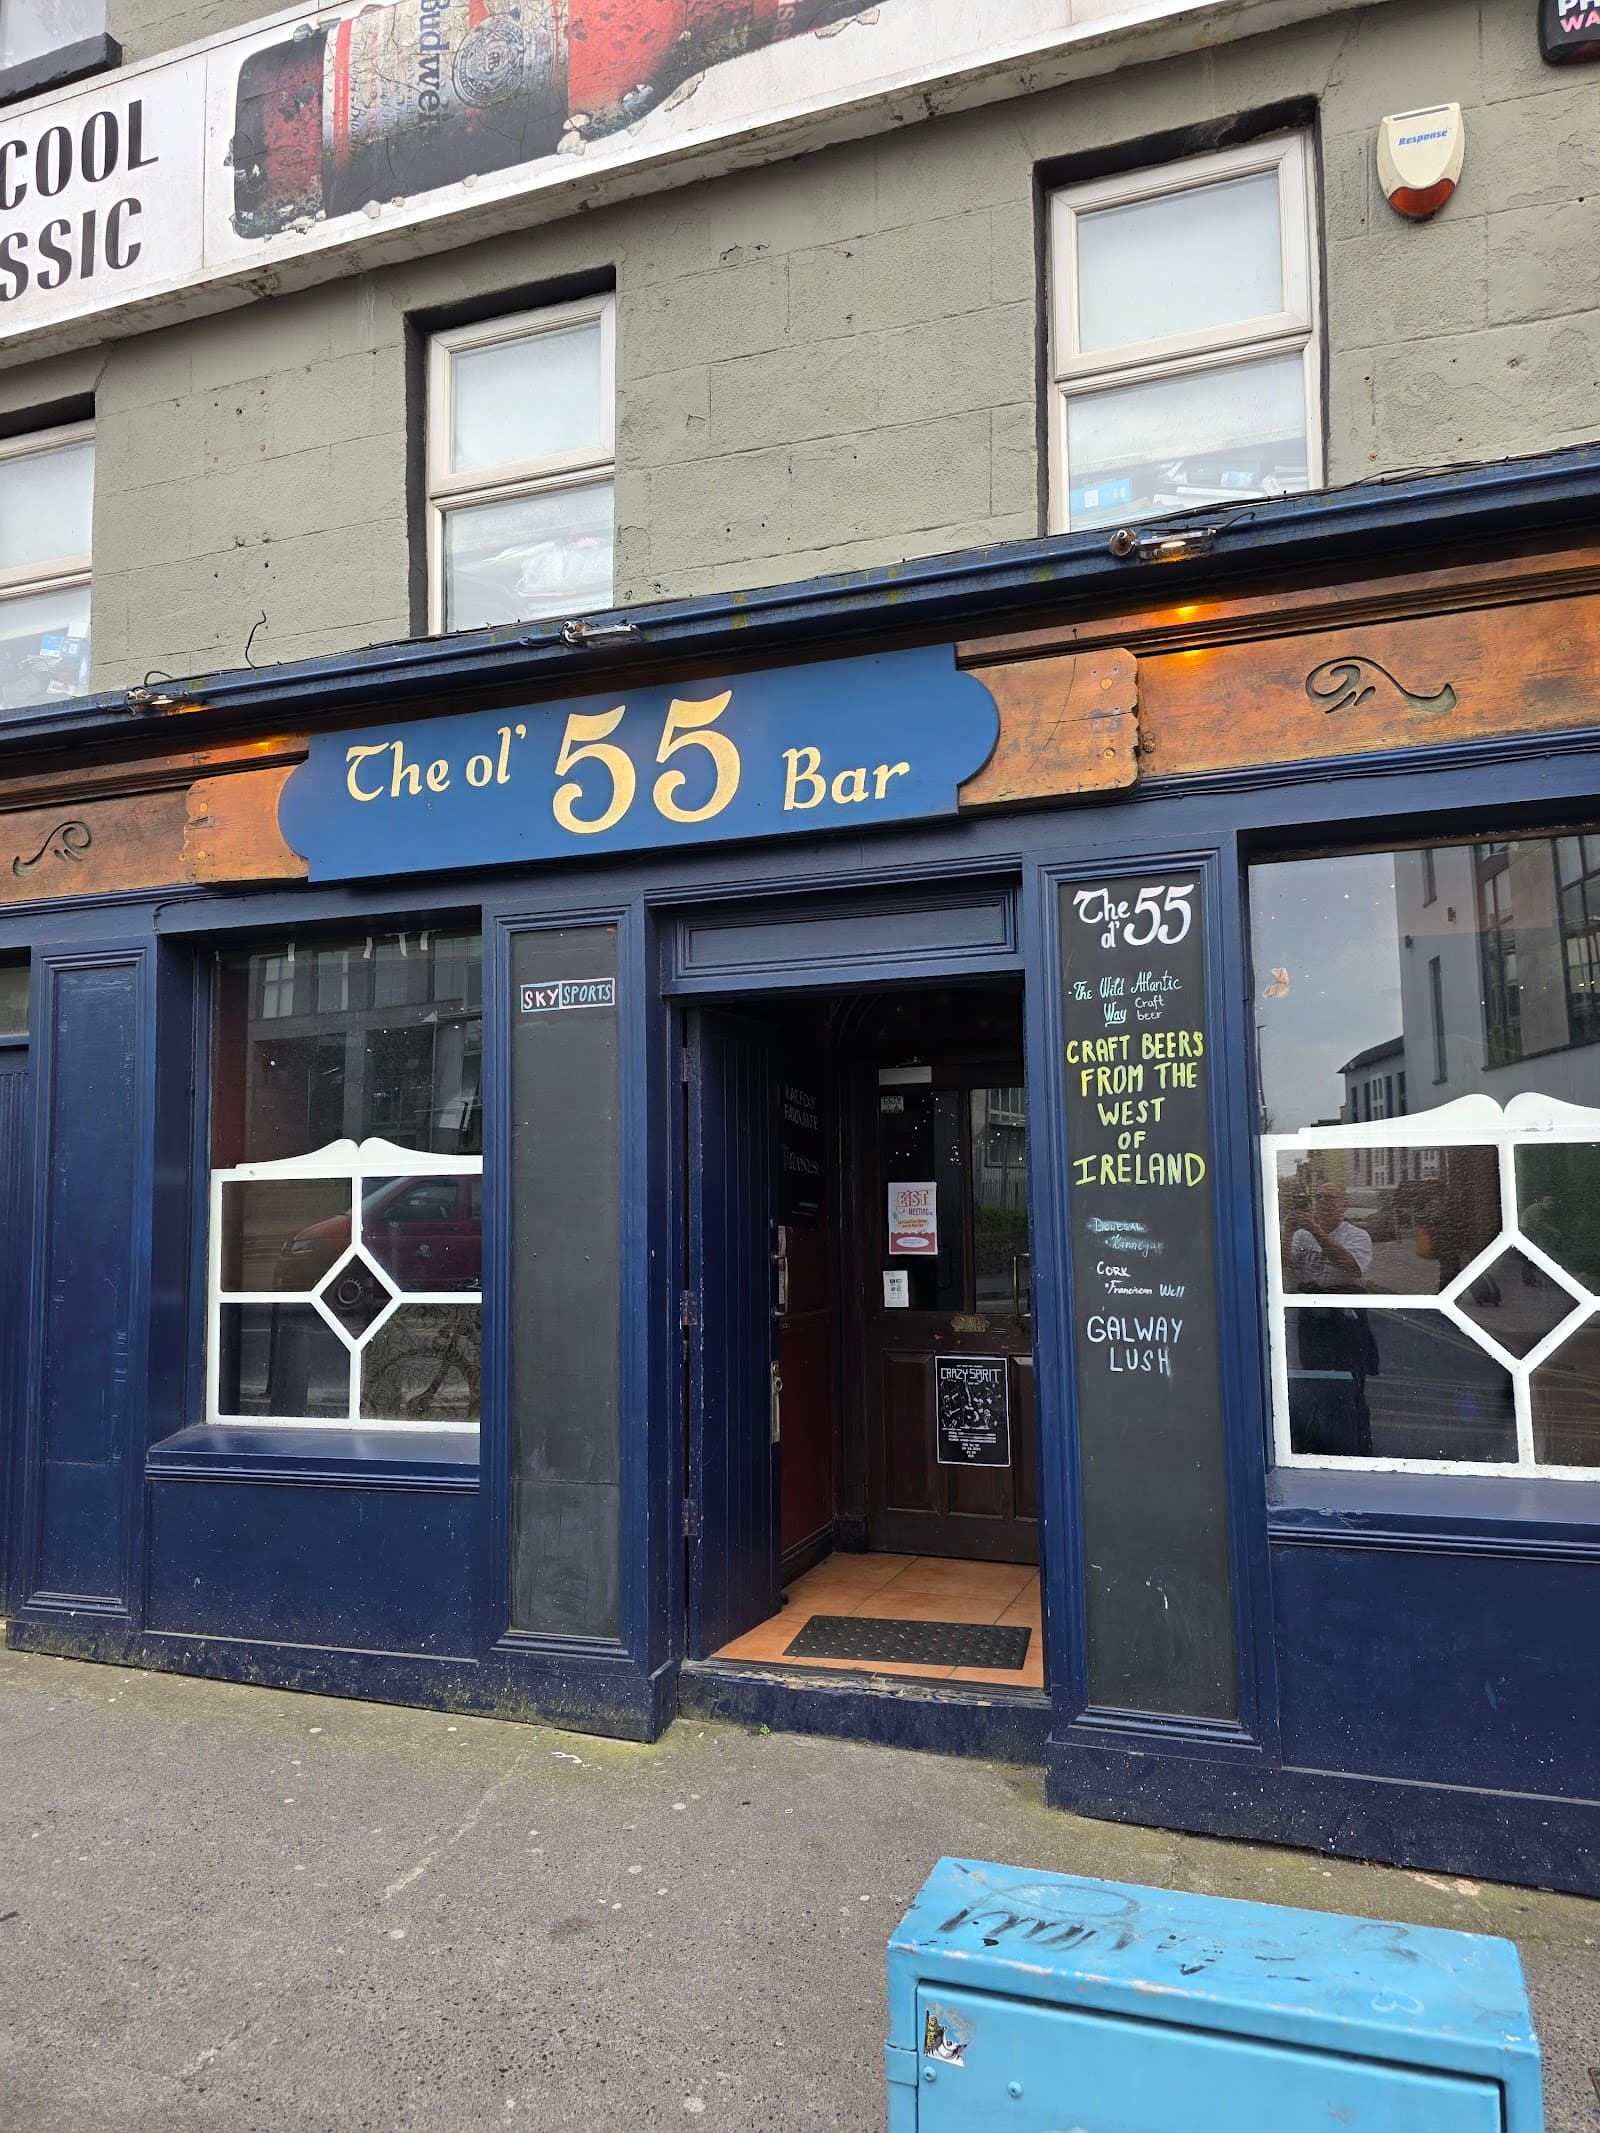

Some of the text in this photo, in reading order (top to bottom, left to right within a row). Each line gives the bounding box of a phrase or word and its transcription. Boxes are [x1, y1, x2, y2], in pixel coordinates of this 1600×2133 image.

[1398, 128, 1448, 146] Response
[0, 99, 159, 211] COOL
[0, 197, 142, 302] SSIC
[346, 690, 910, 834] The ol' 55 Bar
[1073, 884, 1194, 946] The 55
[524, 984, 612, 1010] SKY SPORTS
[1073, 980, 1093, 1001] The
[1100, 976, 1124, 998] Wild
[1135, 995, 1165, 1009] Craft
[1104, 1002, 1127, 1027] Way
[1137, 1010, 1163, 1021] beer
[1066, 1030, 1204, 1064] CRAFT BEERS
[1081, 1062, 1198, 1097] FROM THE
[1097, 1097, 1165, 1126] WEST
[1118, 1130, 1146, 1150] OF
[1073, 1153, 1206, 1187] IRELAND
[1087, 1316, 1183, 1344] GALWAY
[940, 1367, 1003, 1384] CRAZY SPIRIT
[1110, 1347, 1171, 1377] LUSH
